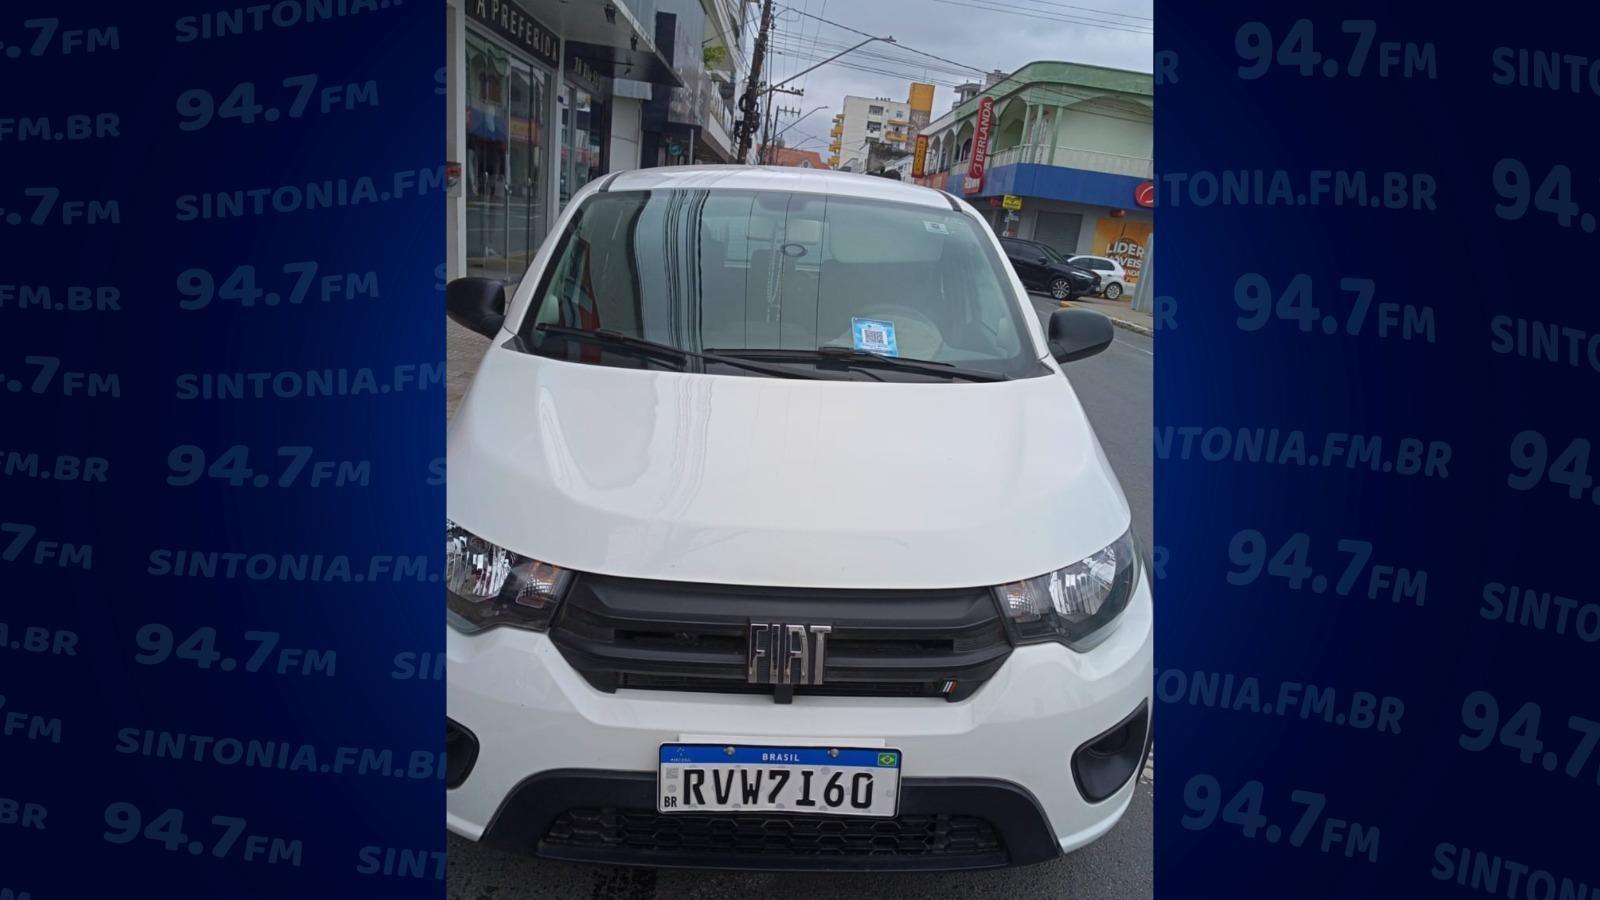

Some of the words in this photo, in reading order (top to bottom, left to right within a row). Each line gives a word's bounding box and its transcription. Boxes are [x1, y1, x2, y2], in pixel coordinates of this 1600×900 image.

[492, 0, 558, 63] PREFERIDA
[975, 101, 993, 163] BERLANDA
[747, 623, 832, 685] FIAT
[762, 752, 800, 762] BRASIL
[664, 796, 678, 808] BR
[683, 768, 874, 809] RVW7I60
